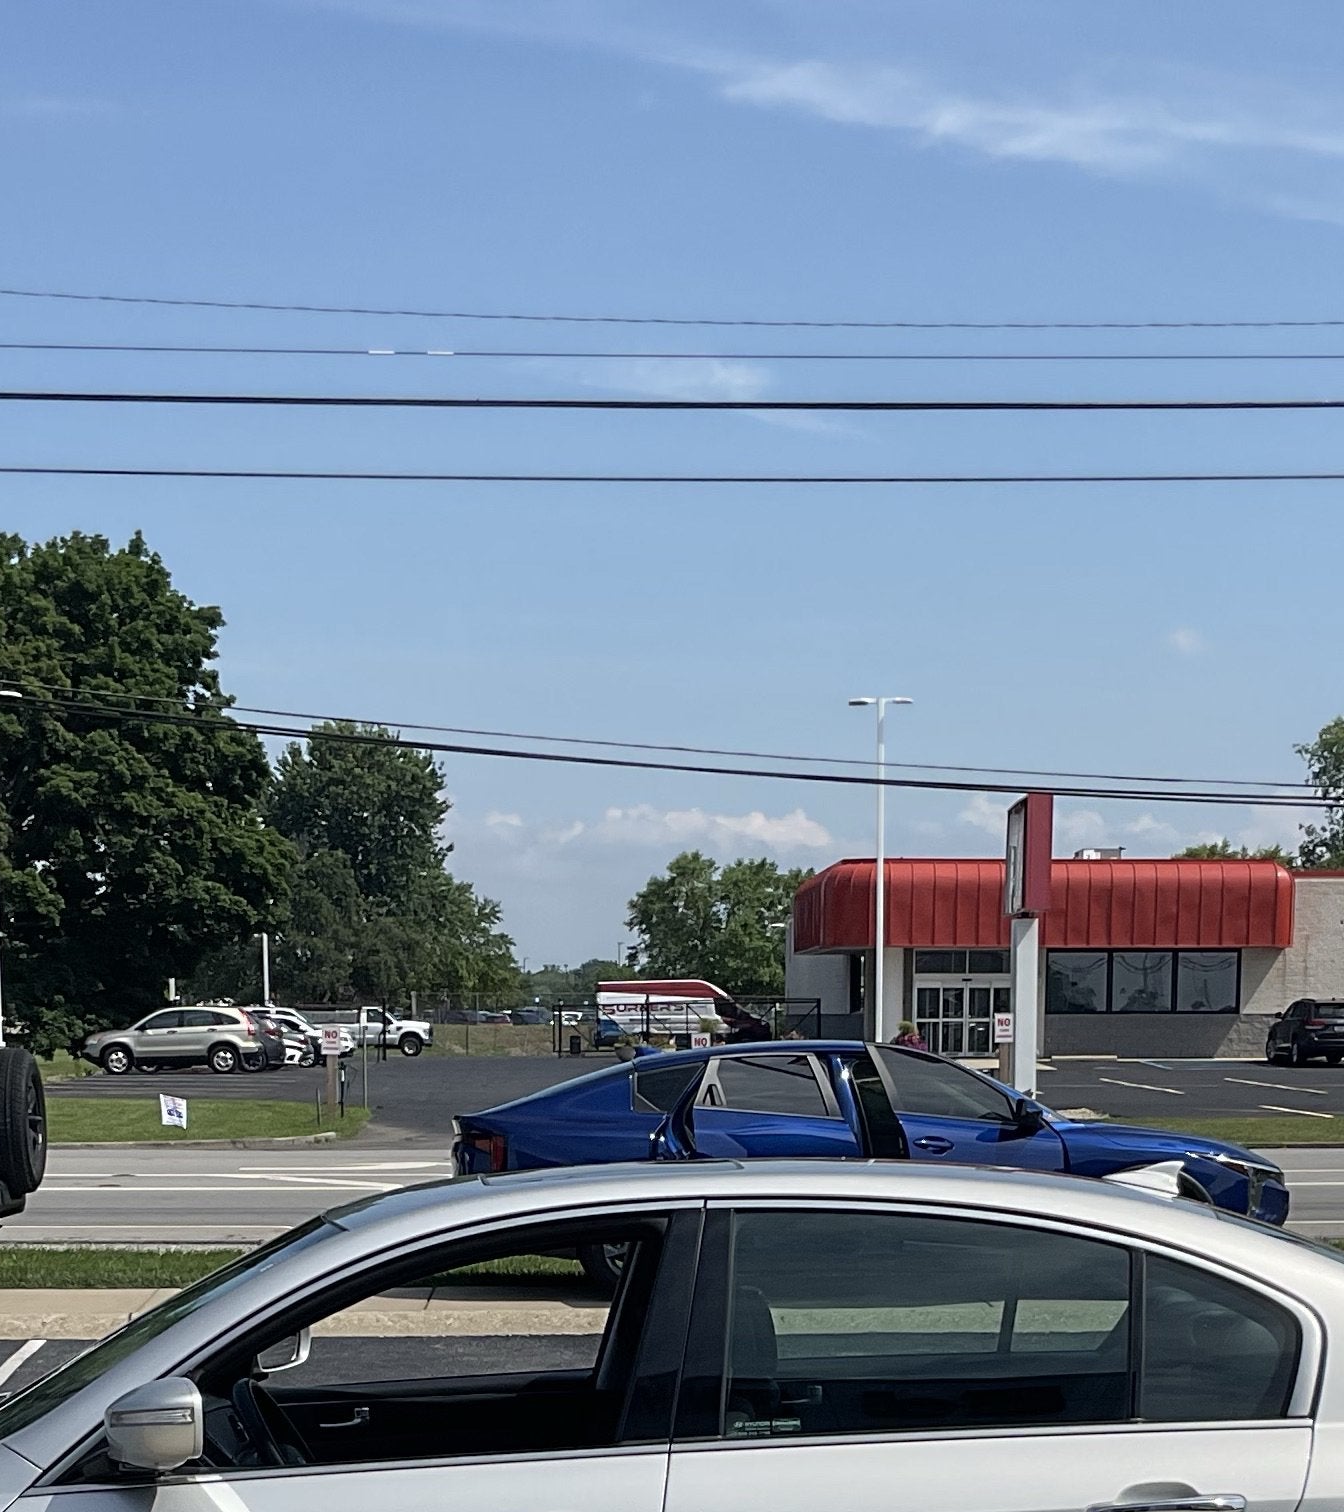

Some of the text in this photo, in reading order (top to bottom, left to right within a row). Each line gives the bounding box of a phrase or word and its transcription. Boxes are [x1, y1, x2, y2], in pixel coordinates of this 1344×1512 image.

[997, 1018, 1011, 1026] NO
[324, 1030, 338, 1038] NO
[694, 1037, 708, 1046] NO
